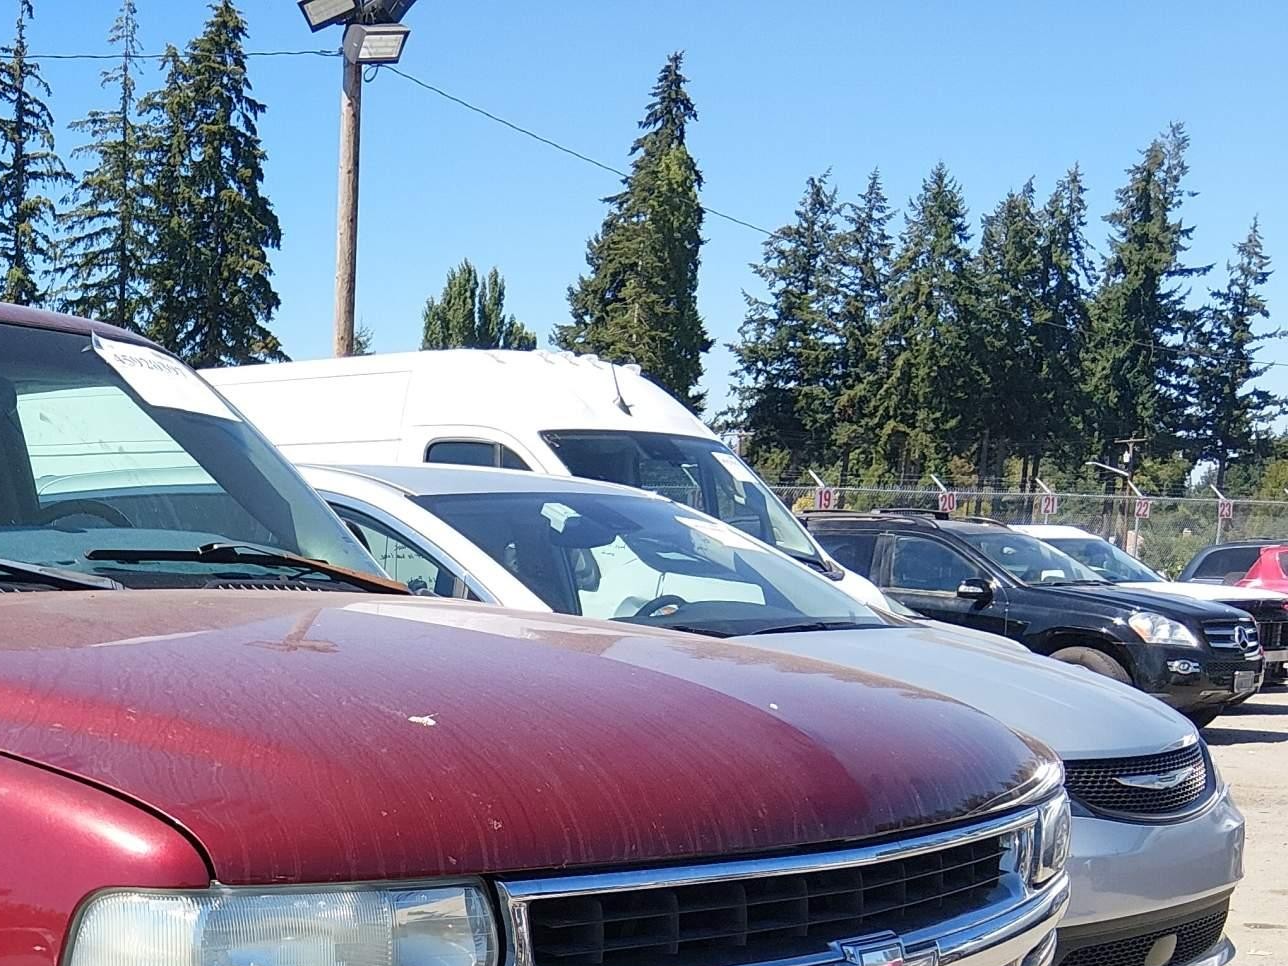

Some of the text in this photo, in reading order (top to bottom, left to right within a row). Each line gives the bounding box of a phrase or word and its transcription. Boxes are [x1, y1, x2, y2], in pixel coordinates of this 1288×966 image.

[818, 490, 832, 509] 19
[940, 493, 955, 511] 20
[1044, 496, 1056, 514] 21
[1136, 501, 1149, 517] 22
[1219, 502, 1232, 518] 23
